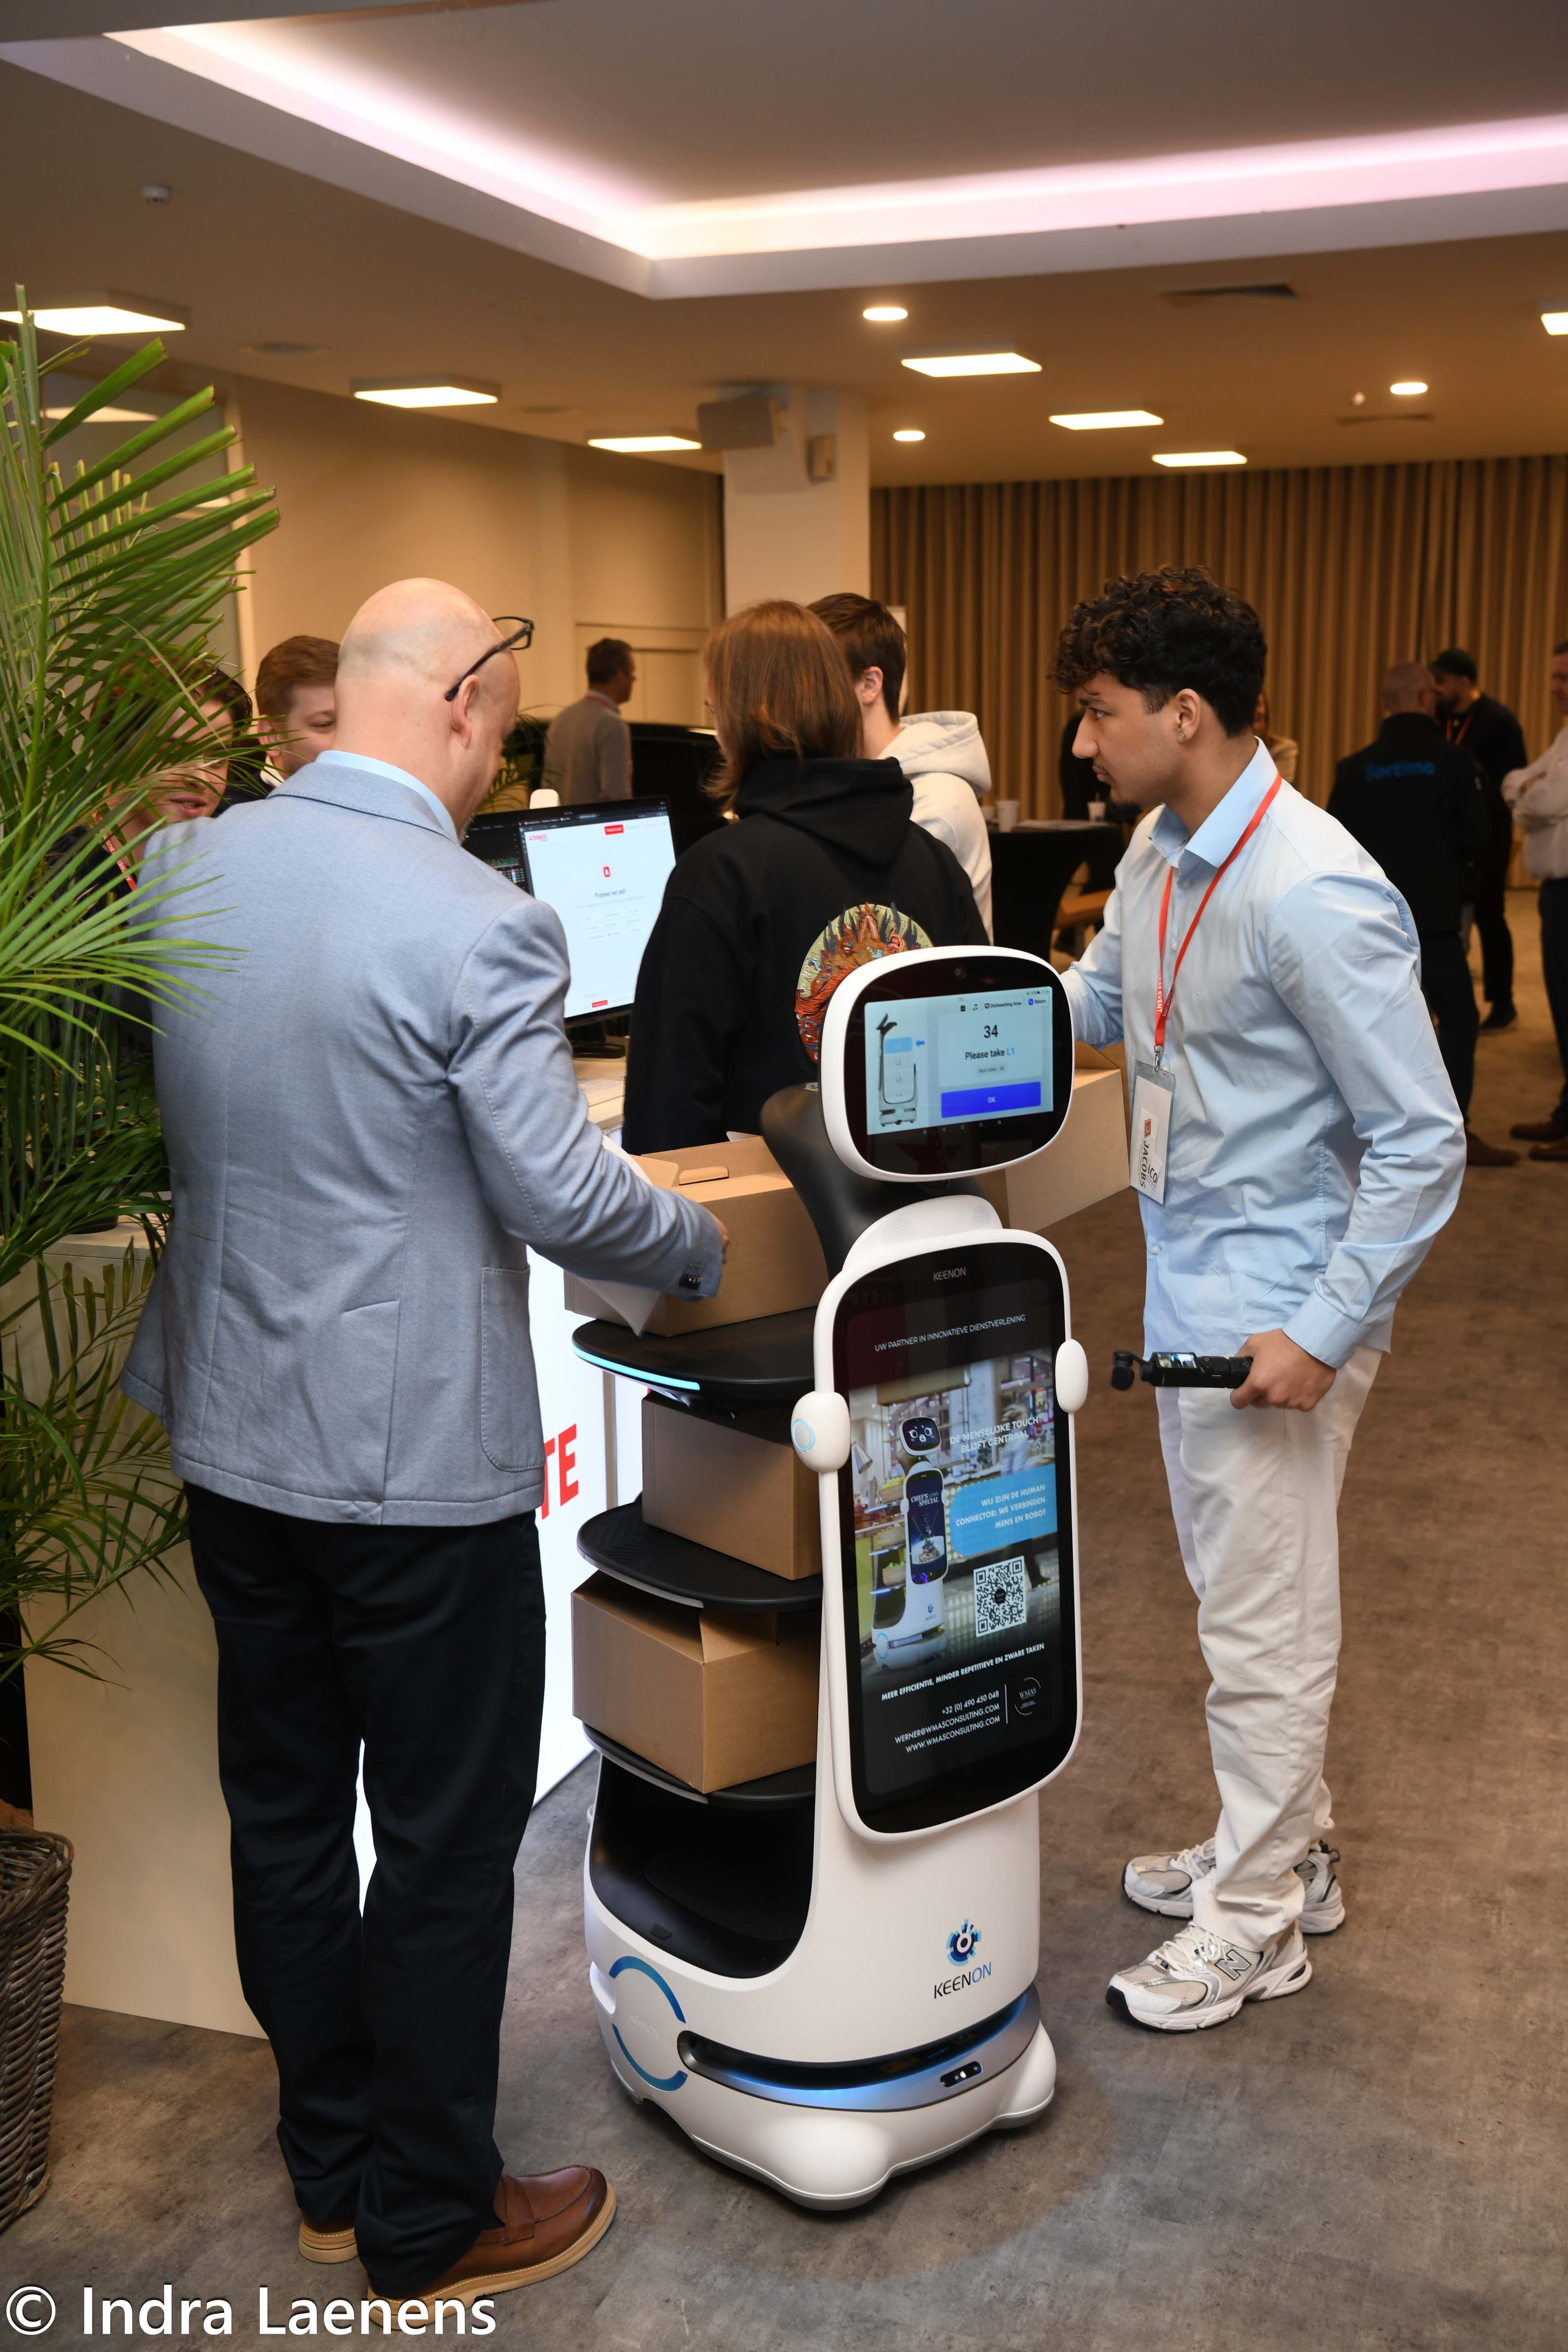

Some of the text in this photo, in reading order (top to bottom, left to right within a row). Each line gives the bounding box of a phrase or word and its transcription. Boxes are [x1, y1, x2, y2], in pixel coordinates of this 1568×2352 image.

[984, 1025, 998, 1038] 34
[965, 1047, 1015, 1060] Please take L1
[1140, 1140, 1149, 1188] JACOBS
[933, 1267, 967, 1281] KEENON
[875, 1314, 1026, 1352] UW PARTNER IN INNOVATIEVE DIENSTVERLENING
[949, 1416, 1039, 1445] DE MENSELIJKE TOUCH
[961, 1430, 1029, 1453] BLIJFT CENTRAAL
[541, 1423, 579, 1520] TE
[918, 1497, 939, 1507] SPECIAL
[981, 1484, 1046, 1507] WIJ ZIJN DE HUMAN
[956, 1496, 1046, 1526] CONNECTOR: WE VERBINDEN
[995, 1508, 1046, 1529] MENS EN ROBOT
[882, 1642, 1045, 1701] MEER EFFICIENTIE, MINDER REPETITIEVE EN ZWARE TAKEN
[941, 1690, 1000, 1715] +32 (0) 490 450 048
[894, 1703, 1000, 1745] WERNER@WMASCONSULTING.COM
[905, 1715, 1000, 1754] WWW.WMASCONSULTING.COM
[934, 1961, 991, 1999] KEENON
